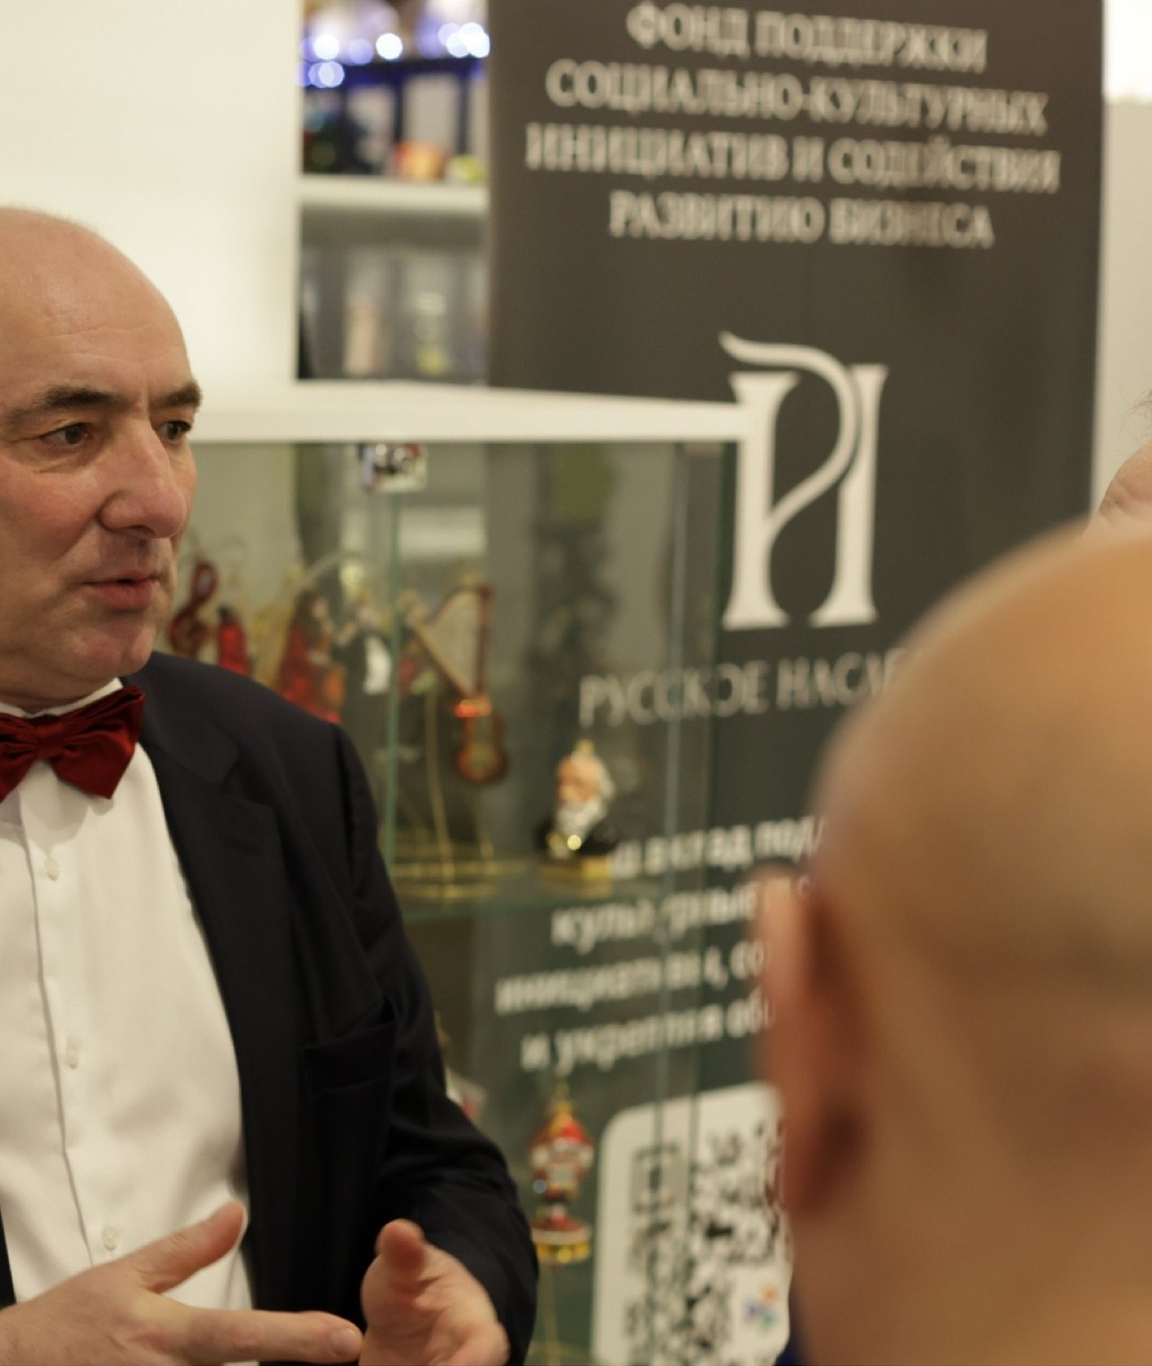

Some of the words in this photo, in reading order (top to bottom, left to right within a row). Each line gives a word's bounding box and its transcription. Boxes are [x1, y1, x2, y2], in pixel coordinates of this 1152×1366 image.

[626, 0, 749, 60] ФОНД
[755, 10, 988, 73] ПОДДЕРЖКИ
[546, 59, 1048, 135] СОЦИАЛЬНО-КУЛЬТУРНЫХ
[526, 122, 789, 181] ИНИЦИАТИВ
[792, 135, 824, 182] И
[828, 135, 1061, 193] СОДЕЙСТВИЯ
[610, 190, 825, 244] РАЗВИТИЮ
[829, 197, 995, 249] БИЗНЕСА
[579, 659, 770, 728] РУССКОЕ
